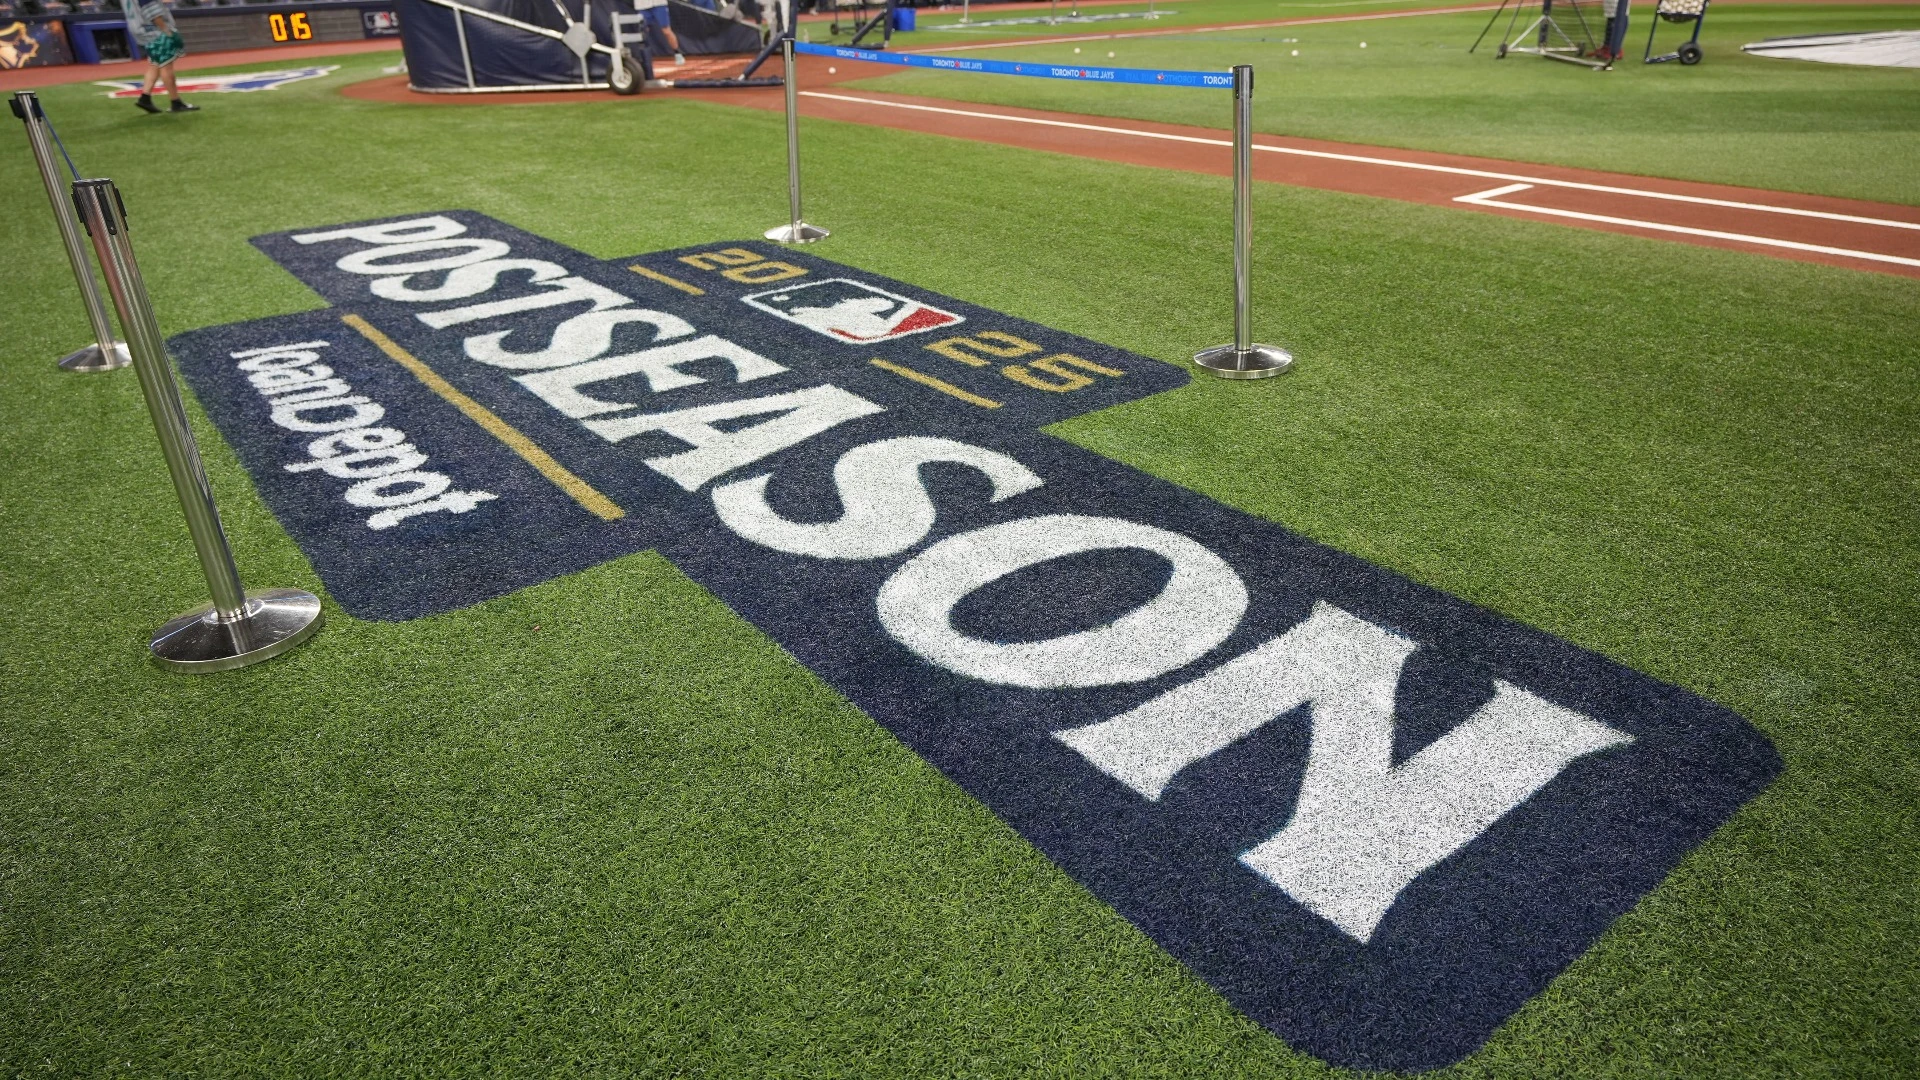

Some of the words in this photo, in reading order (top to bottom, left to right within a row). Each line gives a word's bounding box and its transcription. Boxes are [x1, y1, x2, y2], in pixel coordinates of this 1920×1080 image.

[836, 49, 855, 57] TORONTO
[932, 59, 954, 67] TORONTO
[960, 61, 971, 69] BLUE
[1051, 67, 1080, 78] TORONTO
[1086, 70, 1099, 79] BLUE
[1100, 71, 1114, 79] JAYS
[1203, 75, 1233, 85] TORONT
[677, 247, 809, 284] 20
[923, 330, 1125, 394] 25
[229, 339, 499, 531] loanDepot
[290, 214, 1636, 945] POSTSEASON
